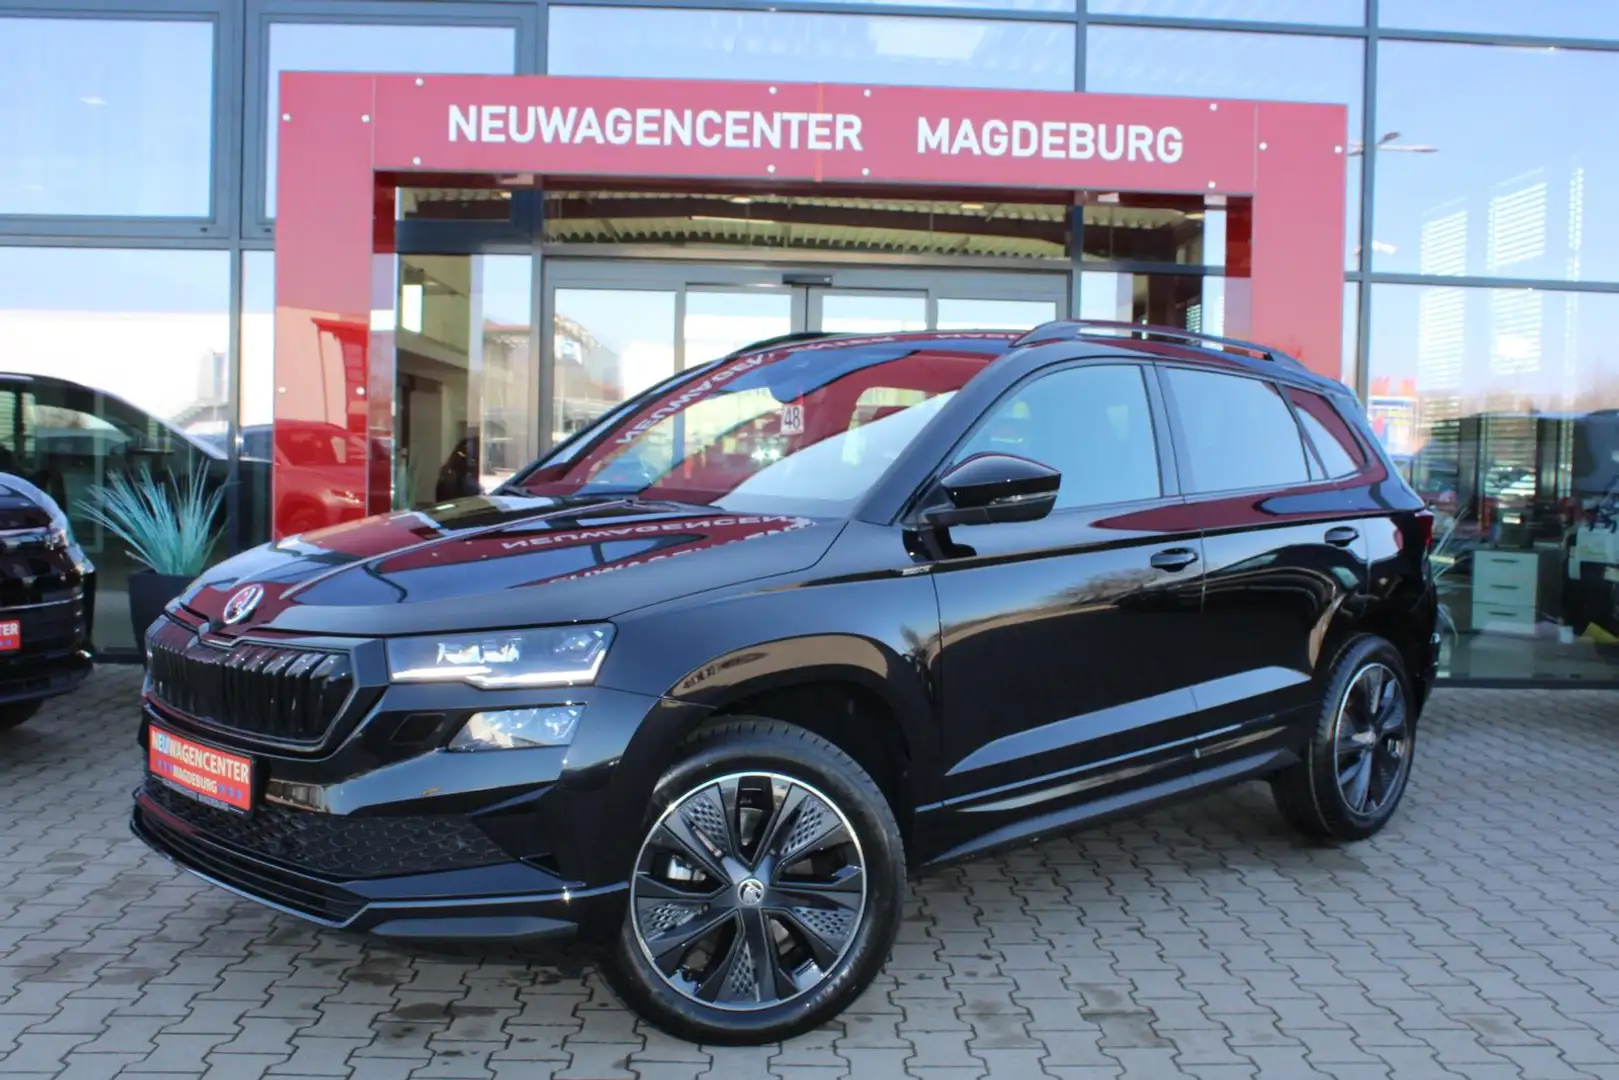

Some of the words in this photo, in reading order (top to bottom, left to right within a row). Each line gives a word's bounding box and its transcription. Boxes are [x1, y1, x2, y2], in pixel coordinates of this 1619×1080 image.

[448, 104, 863, 151] NEUWAGENCENTER
[916, 116, 1184, 164] MAGDEBURG
[783, 406, 802, 431] 48
[151, 730, 250, 785] NEUWAGENCENTER
